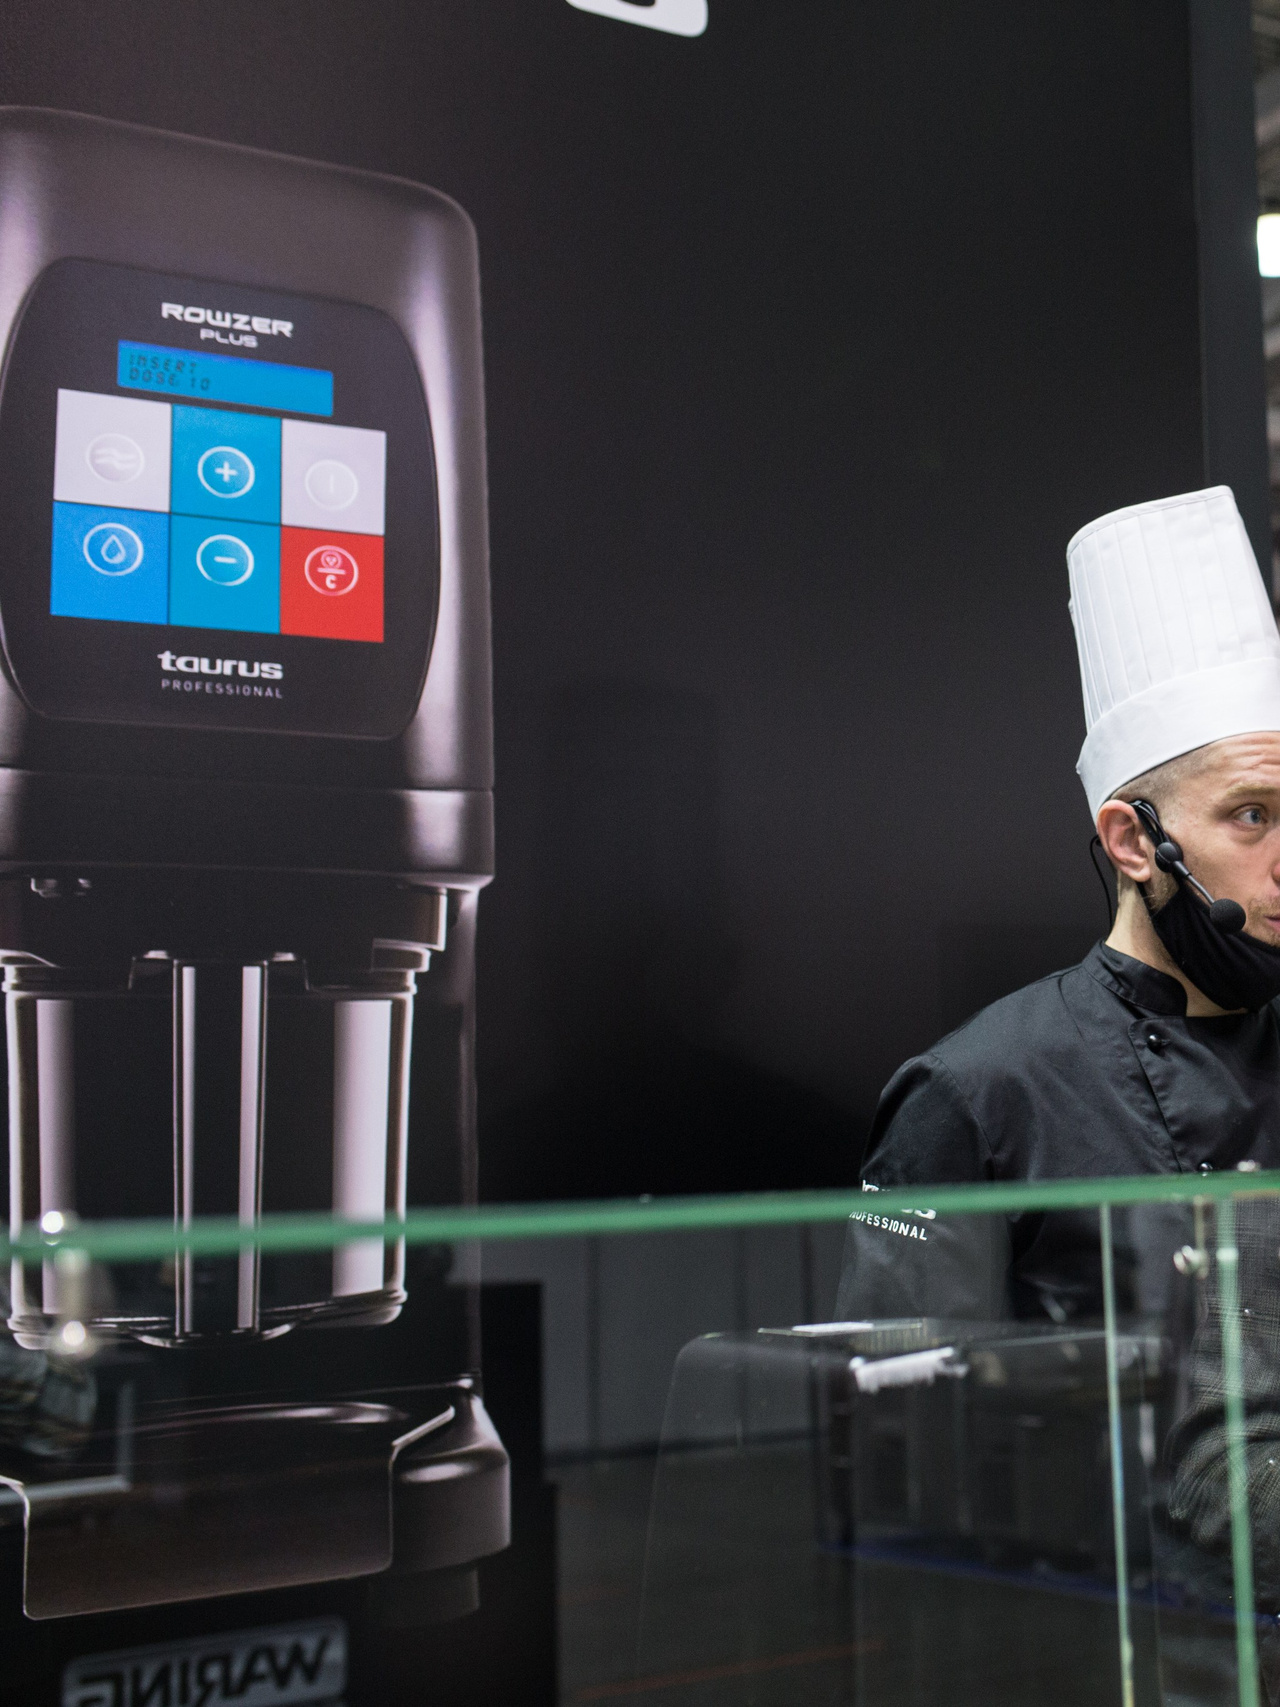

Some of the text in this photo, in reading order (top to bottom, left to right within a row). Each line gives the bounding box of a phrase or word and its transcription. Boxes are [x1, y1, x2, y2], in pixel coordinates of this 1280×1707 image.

[161, 302, 294, 338] ROWZER
[200, 328, 258, 348] PLUS
[128, 353, 198, 374] INSERT
[157, 650, 283, 680] taurus
[160, 678, 283, 699] PROFESSIONAL
